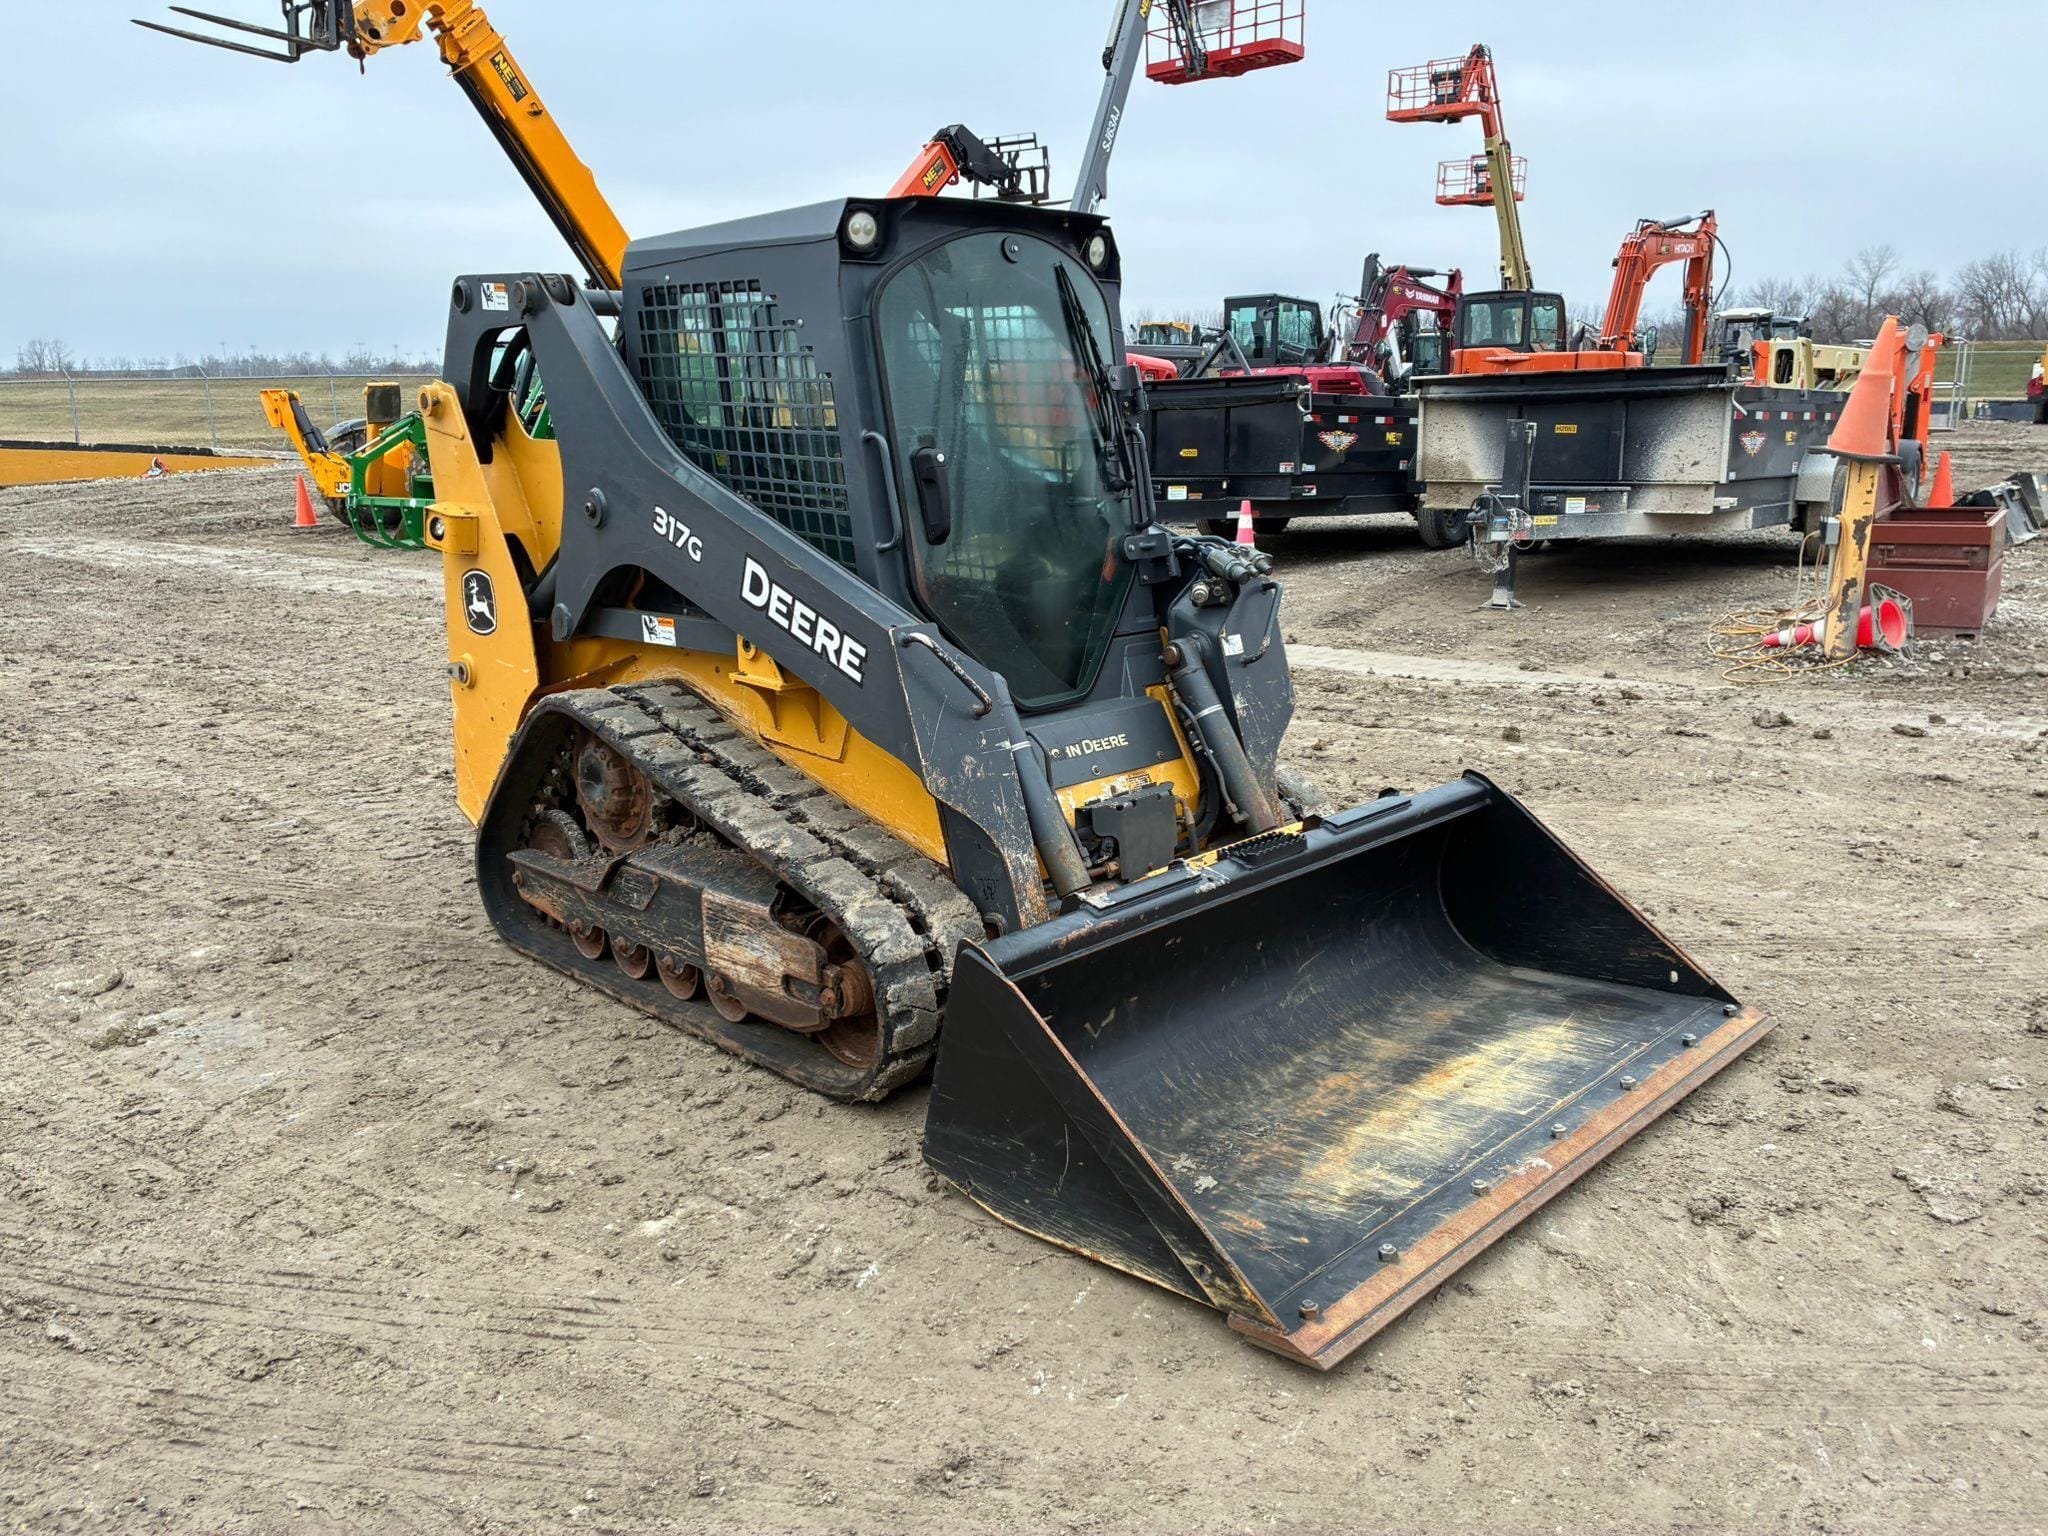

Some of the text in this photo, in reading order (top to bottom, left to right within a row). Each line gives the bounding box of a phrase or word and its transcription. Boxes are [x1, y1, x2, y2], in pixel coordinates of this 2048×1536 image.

[494, 52, 515, 82] NE
[1102, 105, 1121, 153] SJ63AJ
[922, 166, 937, 186] NE
[1415, 290, 1440, 305] YANMAR
[653, 506, 703, 562] 317G
[741, 556, 867, 683] DEERE
[1082, 733, 1129, 755] DEERE
